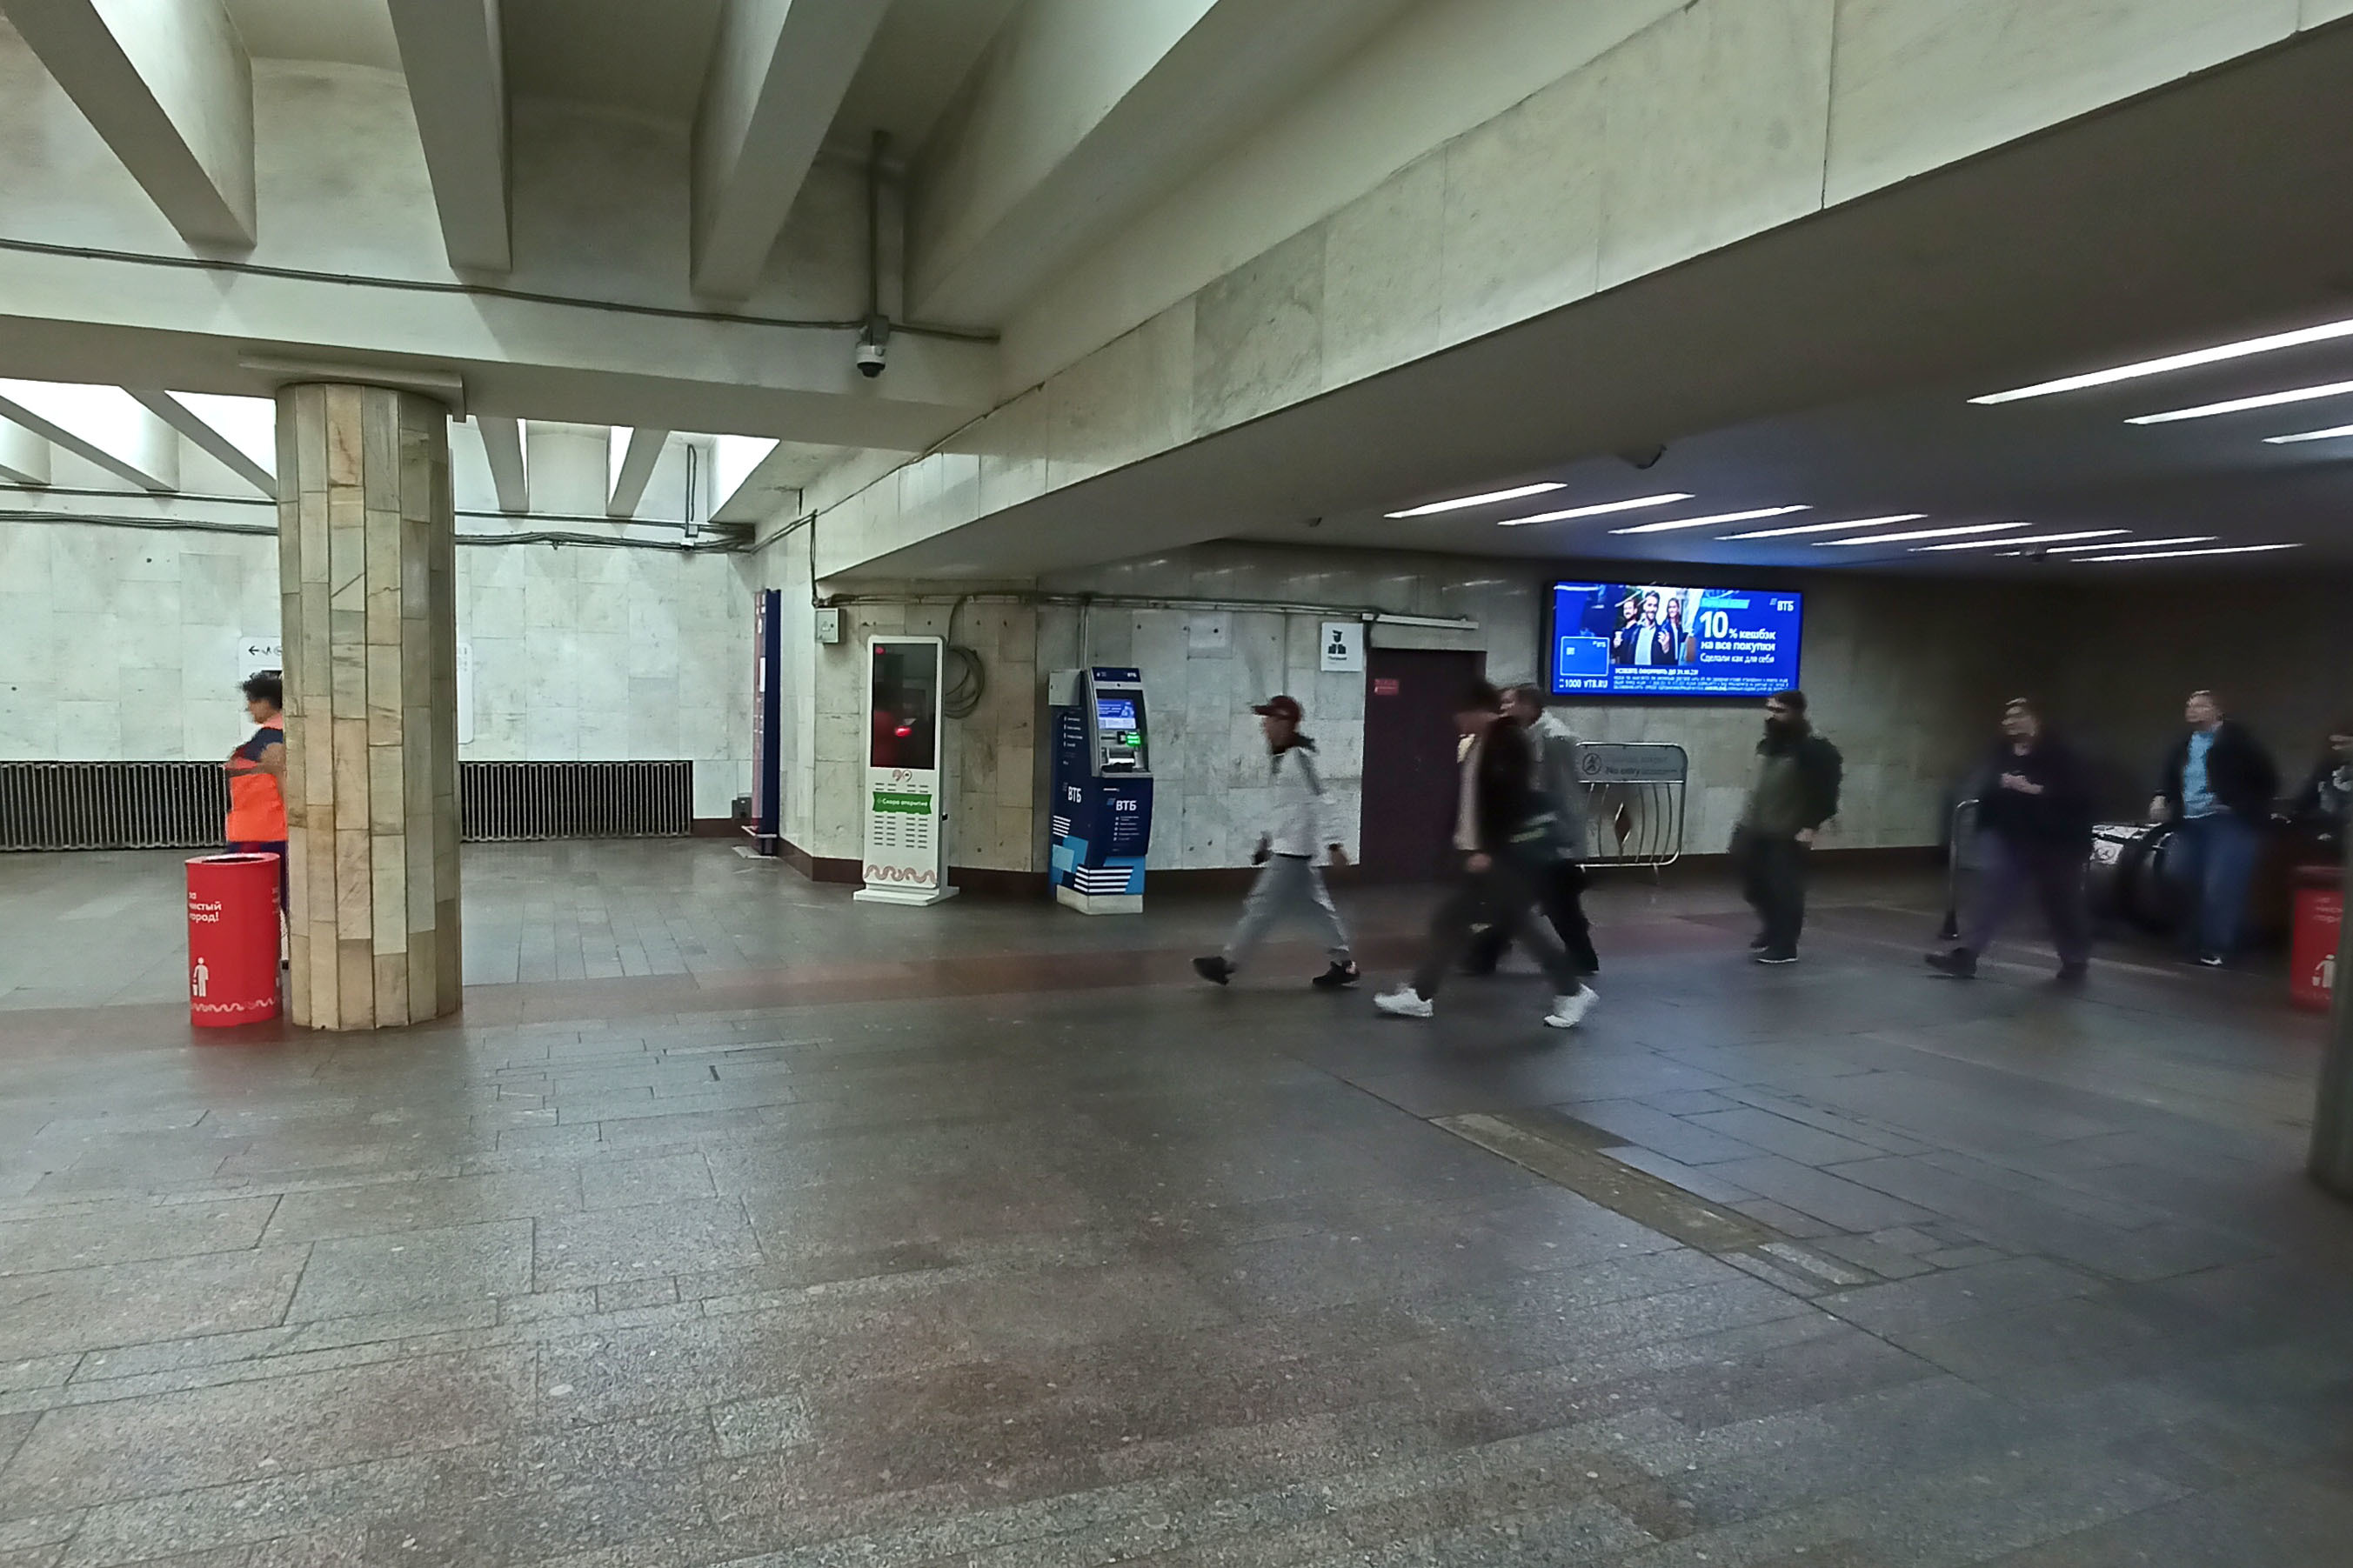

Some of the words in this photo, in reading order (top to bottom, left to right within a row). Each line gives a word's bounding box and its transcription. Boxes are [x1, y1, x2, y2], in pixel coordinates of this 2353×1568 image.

[1777, 600, 1795, 611] ВТБ
[1739, 628, 1776, 639] кешбэк
[1701, 641, 1714, 650] на
[1715, 642, 1732, 651] все
[1733, 643, 1775, 653] покупки
[1700, 653, 1730, 663] Сделали
[1758, 654, 1775, 664] себя
[1565, 678, 1581, 688] 1000
[1068, 786, 1082, 804] ВТБ
[1115, 800, 1137, 811] ВТБ
